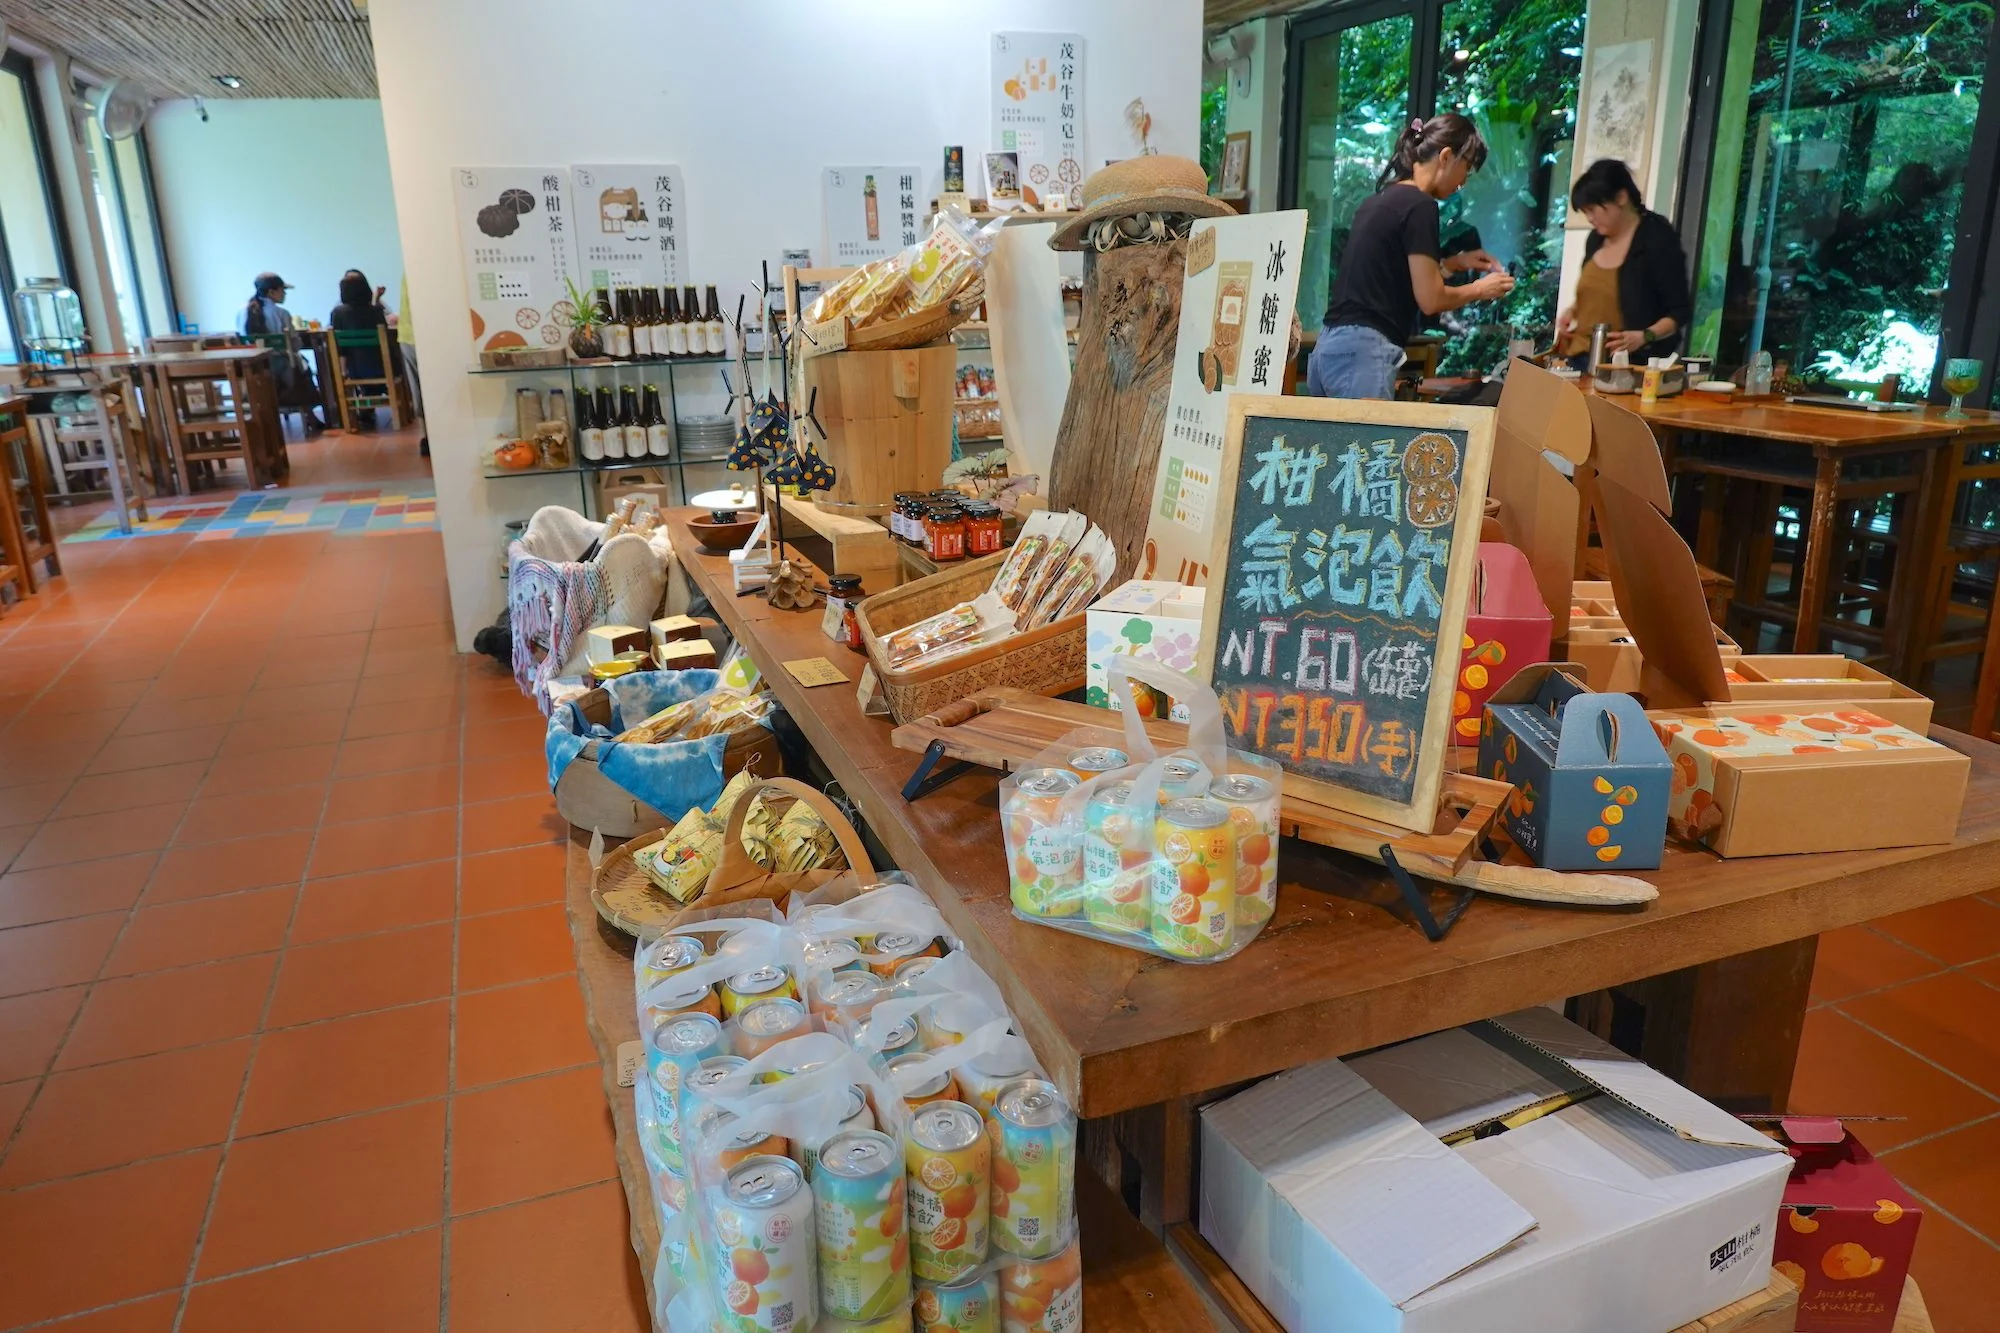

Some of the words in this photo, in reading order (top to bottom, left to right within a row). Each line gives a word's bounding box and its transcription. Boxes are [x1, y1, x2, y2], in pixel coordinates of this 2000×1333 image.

[1060, 42, 1075, 139] 茂谷牛奶皂
[542, 175, 562, 232] 酸柑茶
[655, 175, 676, 252] 茂谷啤酒
[899, 175, 916, 247] 柑橘醬油
[1250, 239, 1287, 388] 冰糖蜜
[1246, 433, 1402, 526] 柑橘
[1236, 514, 1449, 620] 氣泡飲
[1032, 849, 1076, 866] 氣泡飲
